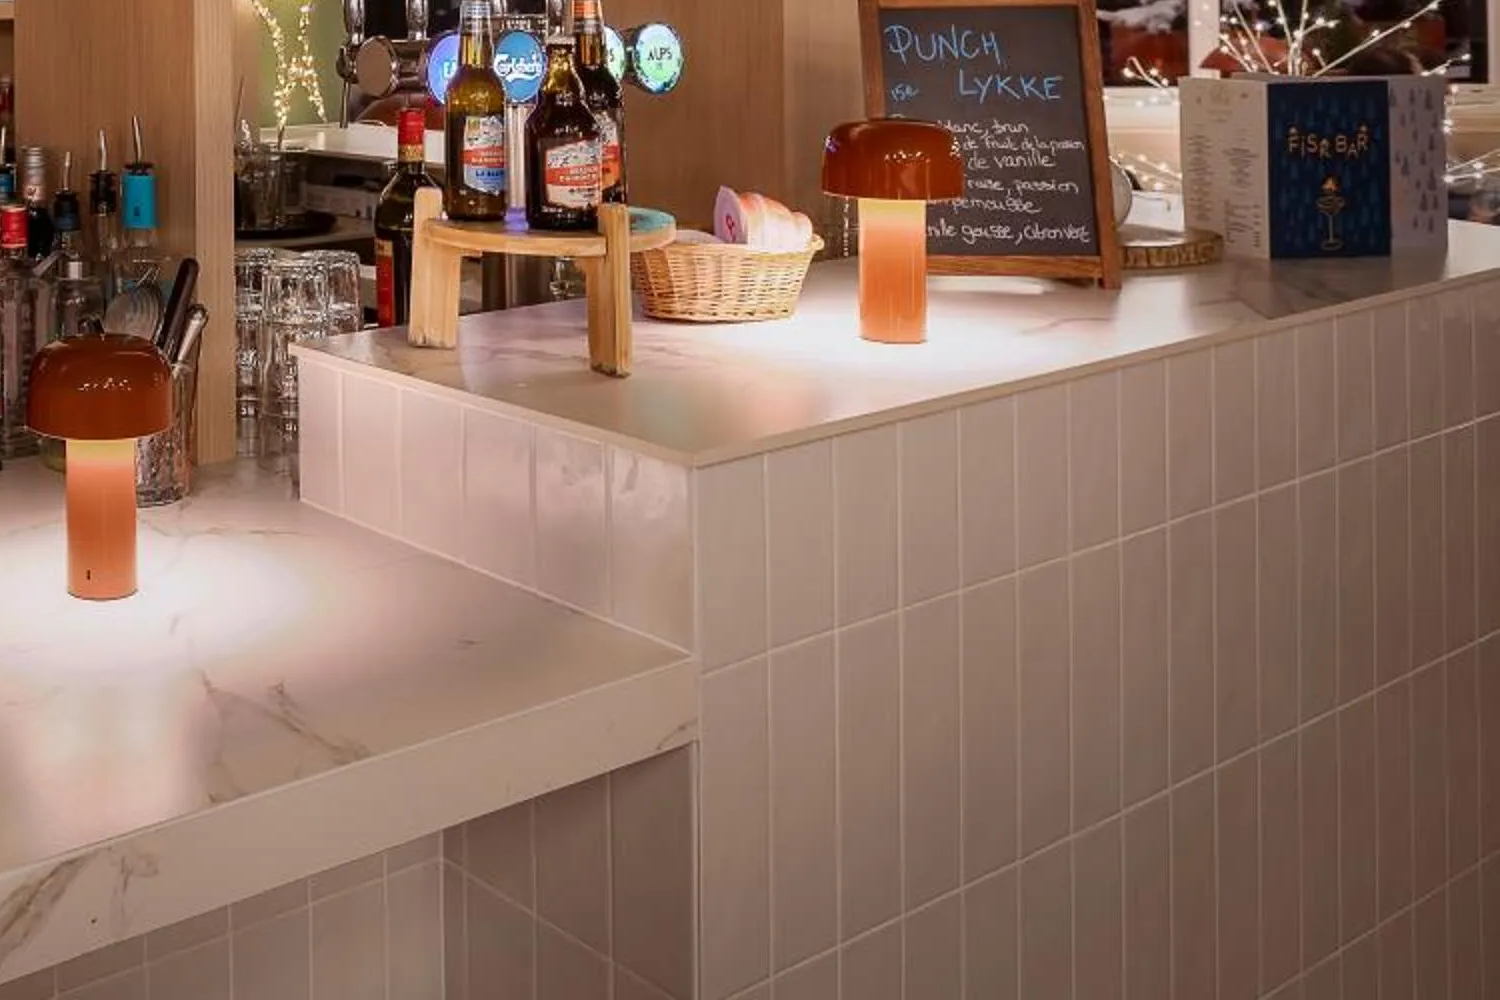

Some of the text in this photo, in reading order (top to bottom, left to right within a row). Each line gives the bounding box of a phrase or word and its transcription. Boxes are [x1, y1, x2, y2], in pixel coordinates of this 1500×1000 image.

[884, 24, 1001, 64] PUNCH
[958, 68, 1063, 104] LYKKE
[993, 151, 1056, 169] vanille
